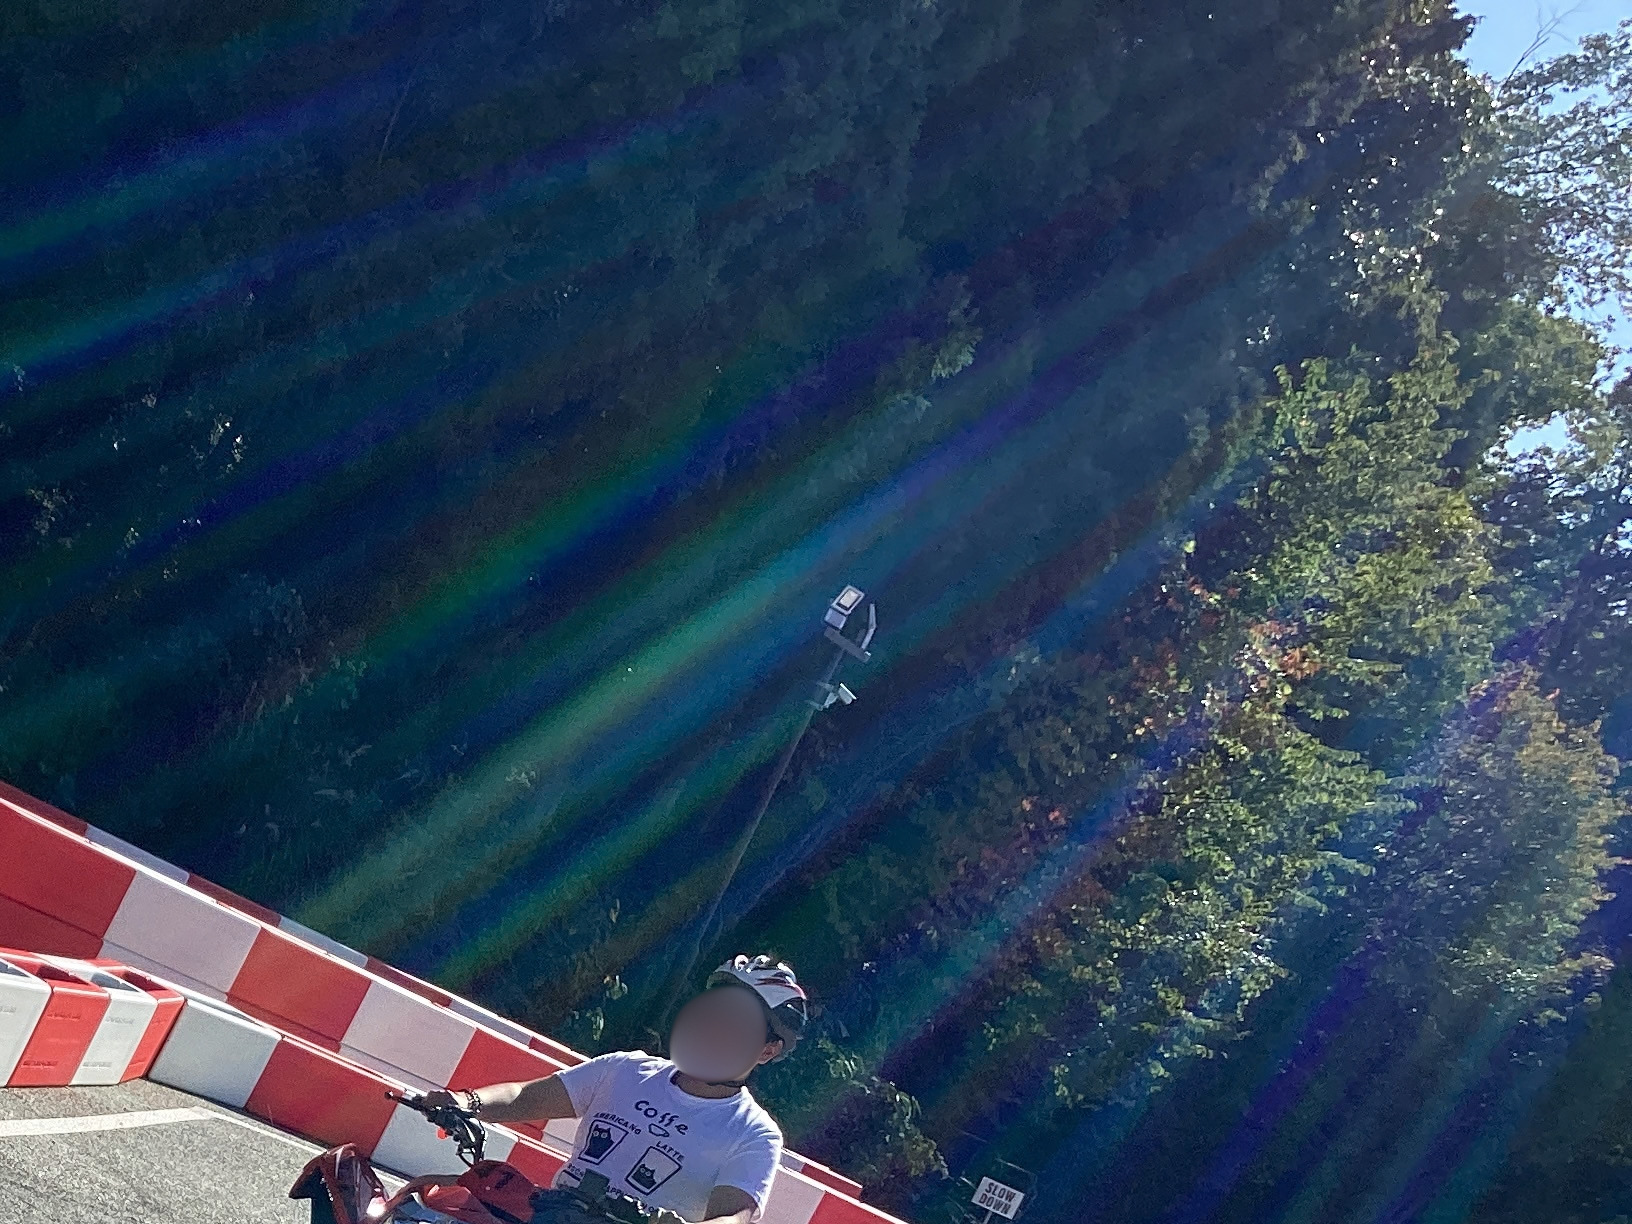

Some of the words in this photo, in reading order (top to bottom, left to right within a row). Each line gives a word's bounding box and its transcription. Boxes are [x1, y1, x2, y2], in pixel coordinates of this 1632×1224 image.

[593, 1112, 642, 1135] AMERICANO
[655, 1140, 685, 1161] LATTE
[985, 1183, 1016, 1202] SLOW
[979, 1193, 1011, 1214] DOWN
